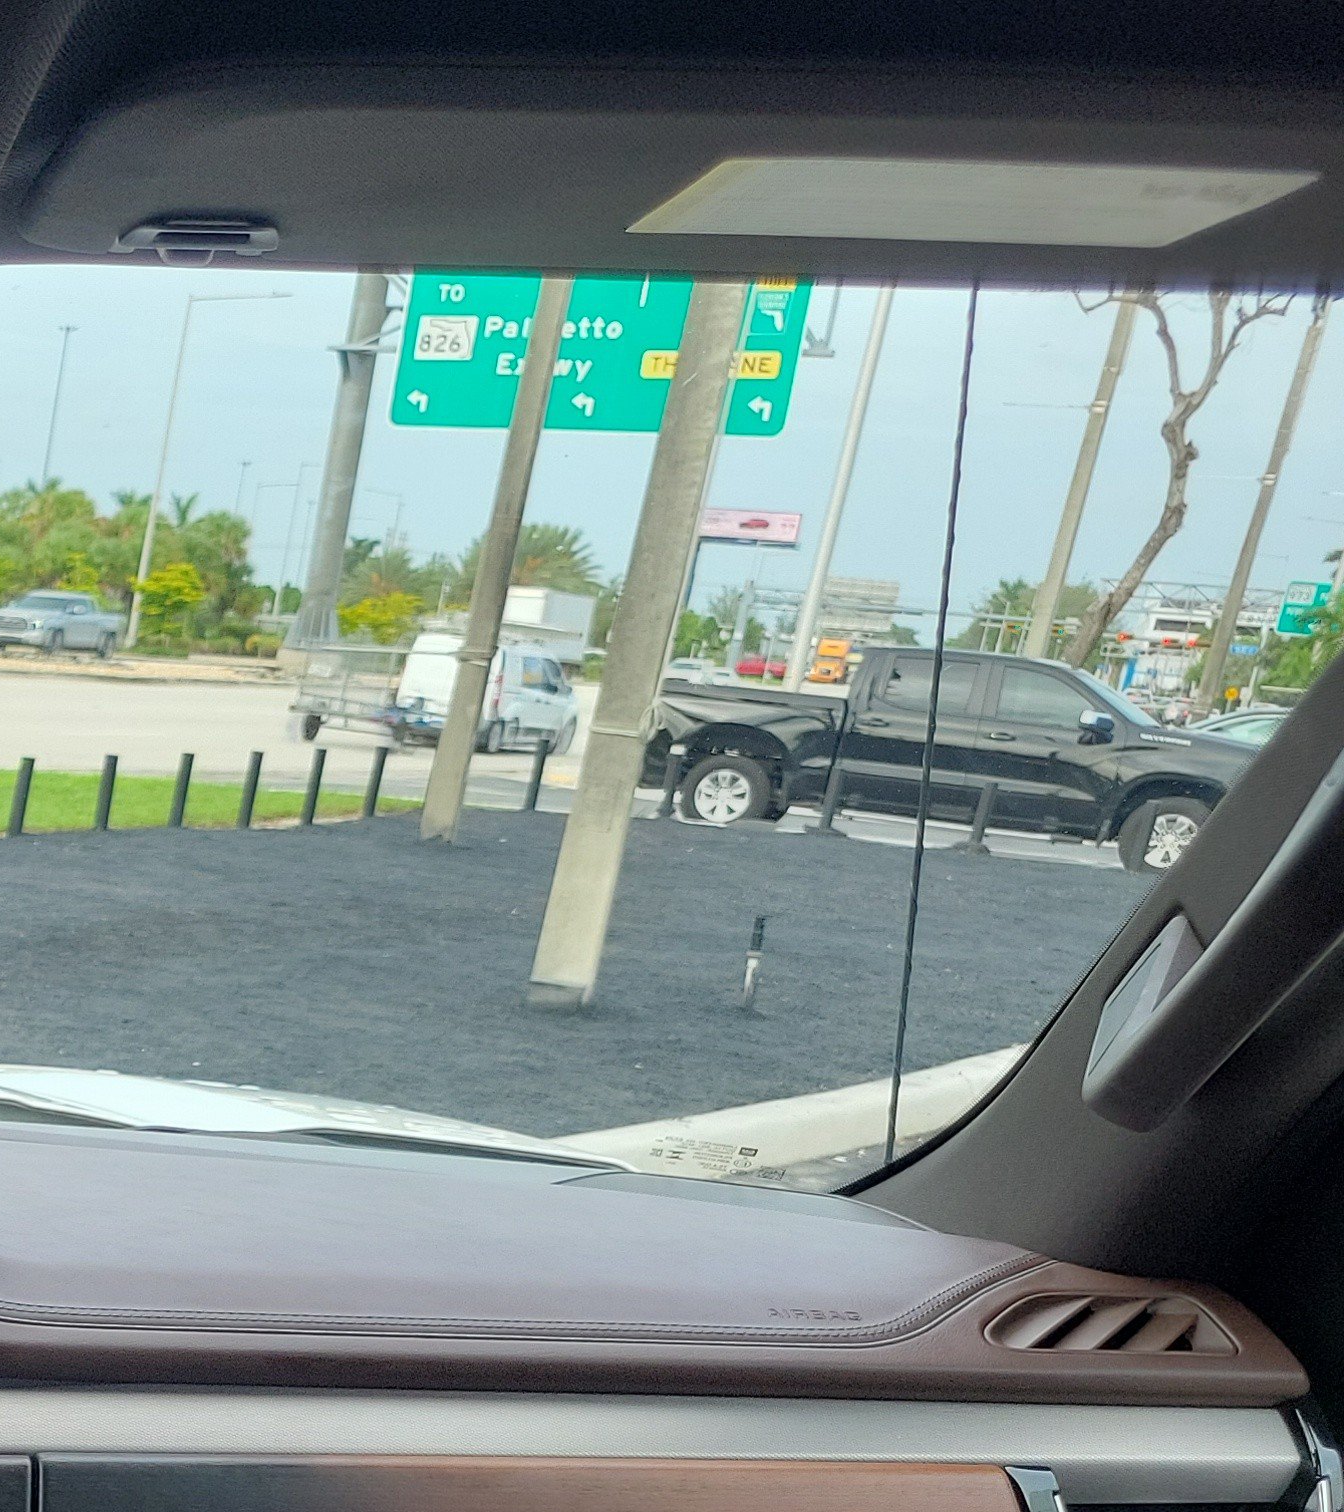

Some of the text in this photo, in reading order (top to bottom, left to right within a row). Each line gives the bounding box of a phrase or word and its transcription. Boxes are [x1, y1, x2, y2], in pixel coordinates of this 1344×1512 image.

[438, 283, 466, 302] TO
[483, 315, 623, 340] Paletto
[419, 334, 461, 353] 826
[767, 1306, 862, 1322] AIRBAG
